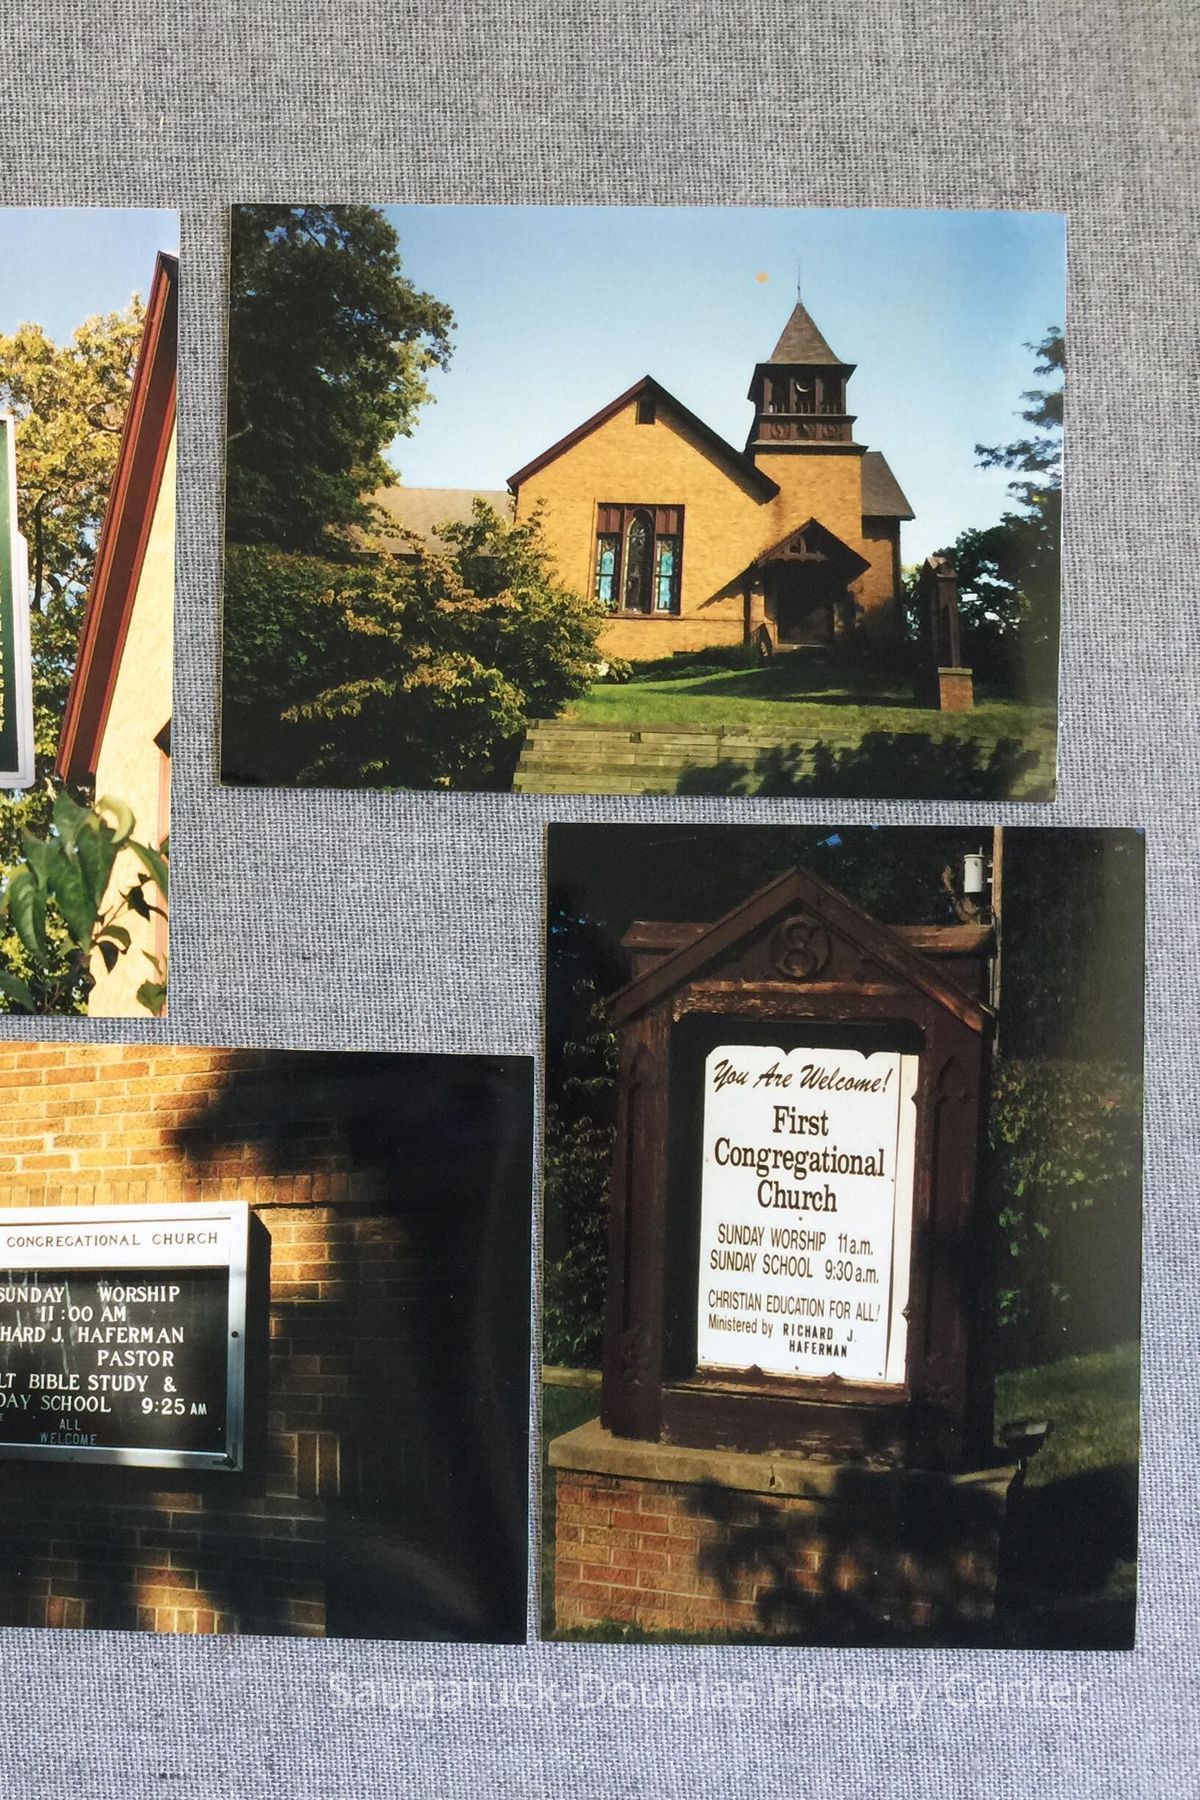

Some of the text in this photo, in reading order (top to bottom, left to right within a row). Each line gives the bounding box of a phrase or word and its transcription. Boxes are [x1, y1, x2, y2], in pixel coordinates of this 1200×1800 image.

[713, 1059, 893, 1093] You Are Welcome!
[772, 1105, 829, 1136] First
[714, 1137, 885, 1180] Congregational
[757, 1179, 837, 1212] Church
[7, 1234, 141, 1247] CONGREGATIONAL
[152, 1232, 218, 1245] CHURCH
[718, 1223, 765, 1247] SUNDAY
[771, 1227, 827, 1251] WORSHIP
[710, 1249, 757, 1272] SUNDAY
[763, 1254, 813, 1278] SCHOOL
[99, 1286, 181, 1302] WORSHIP
[100, 1305, 126, 1322] AM
[708, 1289, 881, 1322] CHRISTIAN EDUCATION FOR ALL!
[51, 1327, 64, 1344] J.
[78, 1326, 184, 1344] HAFERMAN
[708, 1314, 757, 1333] Ministered
[762, 1319, 773, 1339] by
[783, 1323, 833, 1340] RICHARD
[789, 1340, 847, 1357] HAFERMAN
[97, 1350, 174, 1367] PASTOR
[29, 1374, 80, 1390] BIBLE
[88, 1374, 149, 1392] STUDY
[163, 1376, 177, 1392] &
[40, 1396, 111, 1413] SCHOOL
[141, 1398, 186, 1415] 9:25
[190, 1403, 208, 1415] AM
[59, 1418, 81, 1431] ALL
[40, 1433, 98, 1446] WELCOME
